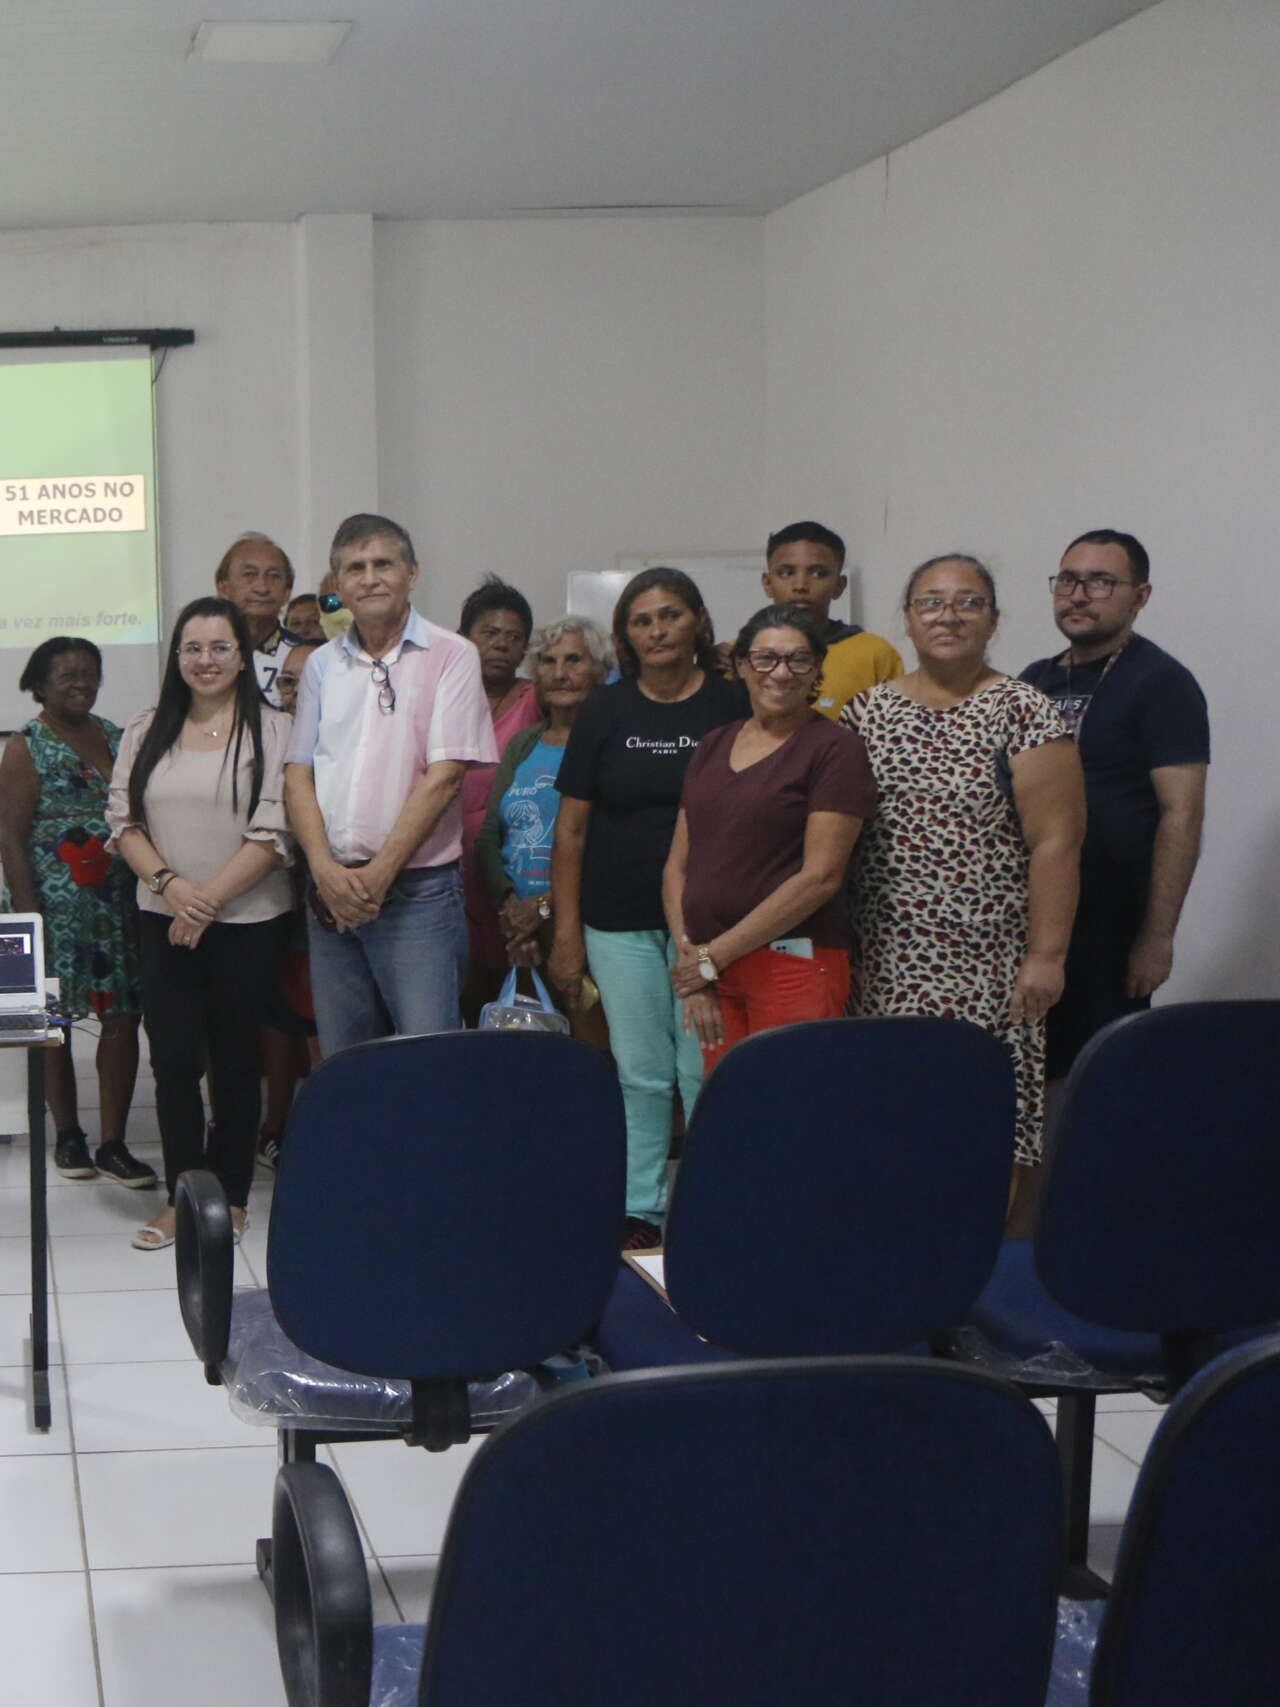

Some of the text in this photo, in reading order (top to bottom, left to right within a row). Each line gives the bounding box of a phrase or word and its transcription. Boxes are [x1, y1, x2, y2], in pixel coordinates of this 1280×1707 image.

[5, 481, 134, 501] 51 ANOS NO
[17, 507, 123, 526] MERCADO
[13, 616, 42, 630] vez
[49, 613, 91, 628] mais
[625, 735, 676, 748] Christian
